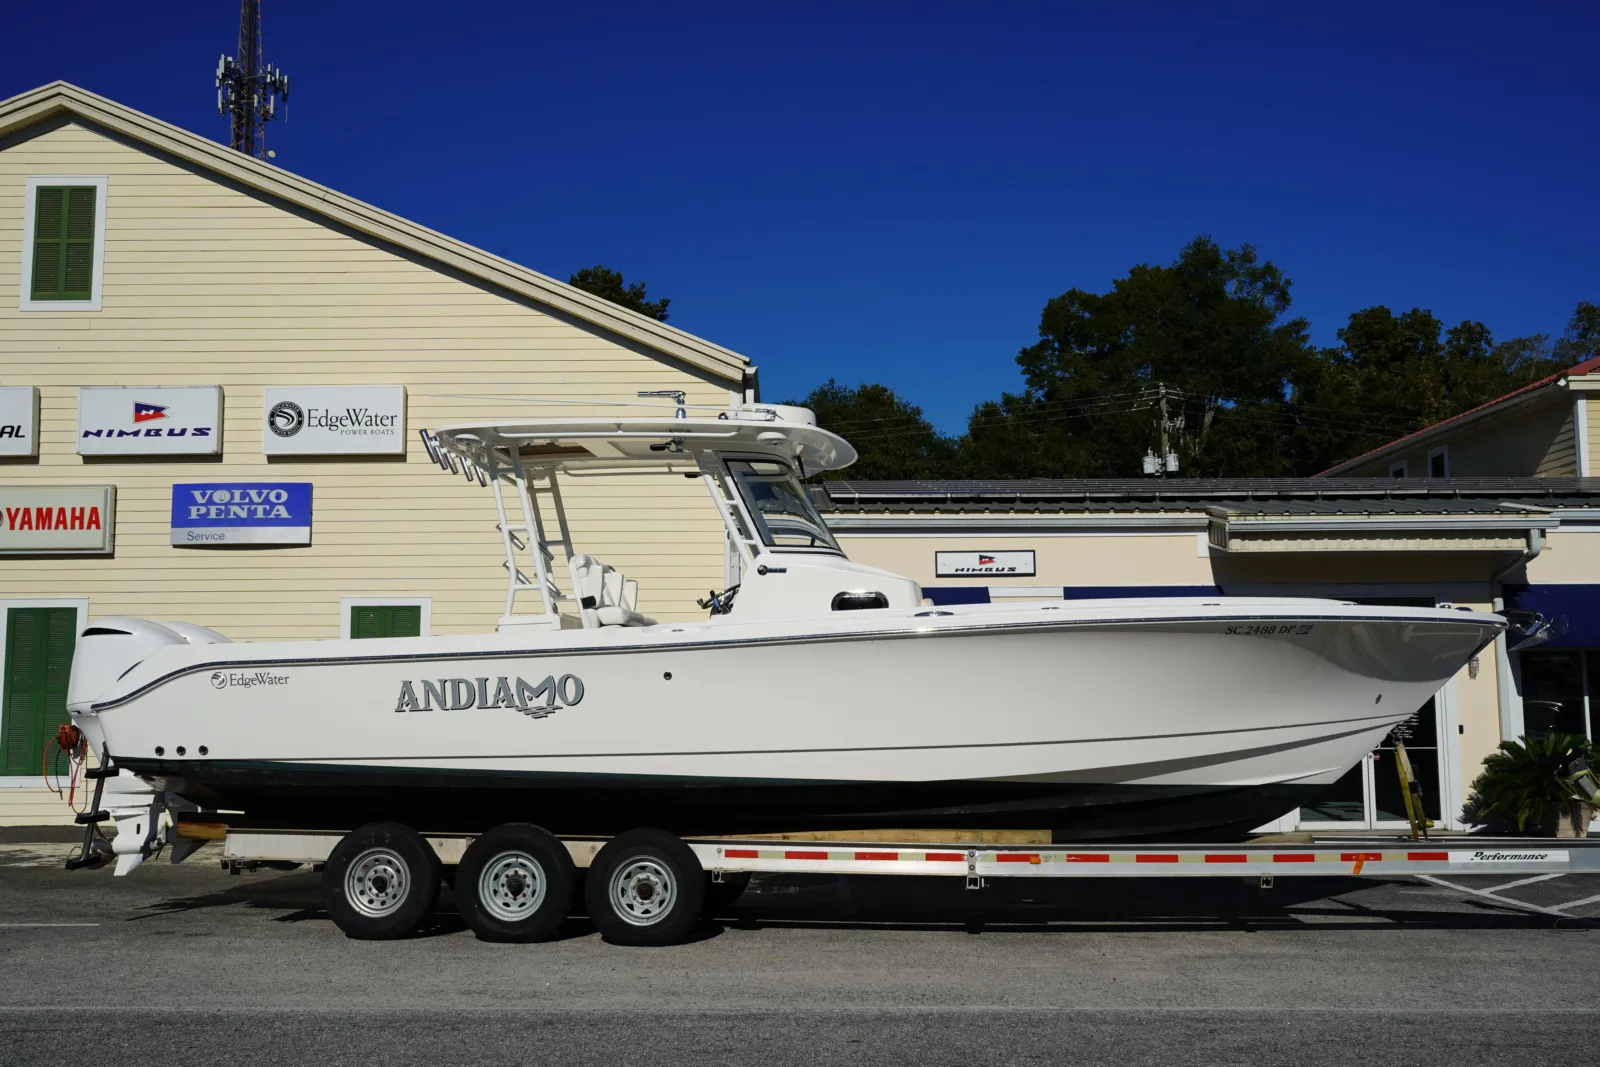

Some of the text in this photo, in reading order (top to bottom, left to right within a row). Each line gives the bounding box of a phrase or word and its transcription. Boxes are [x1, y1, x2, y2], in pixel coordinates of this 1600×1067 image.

[306, 408, 398, 432] EdgeWater
[82, 427, 212, 438] NIMBUS
[190, 489, 289, 504] VOLVO
[5, 506, 102, 531] YAMAHA
[188, 505, 293, 519] PENTA
[186, 531, 226, 542] Service
[1225, 625, 1242, 635] SC
[1244, 625, 1276, 635] 2488
[229, 672, 290, 688] EdgeWater
[394, 673, 585, 715] ANDIAMO
[1470, 851, 1548, 861] Performance
